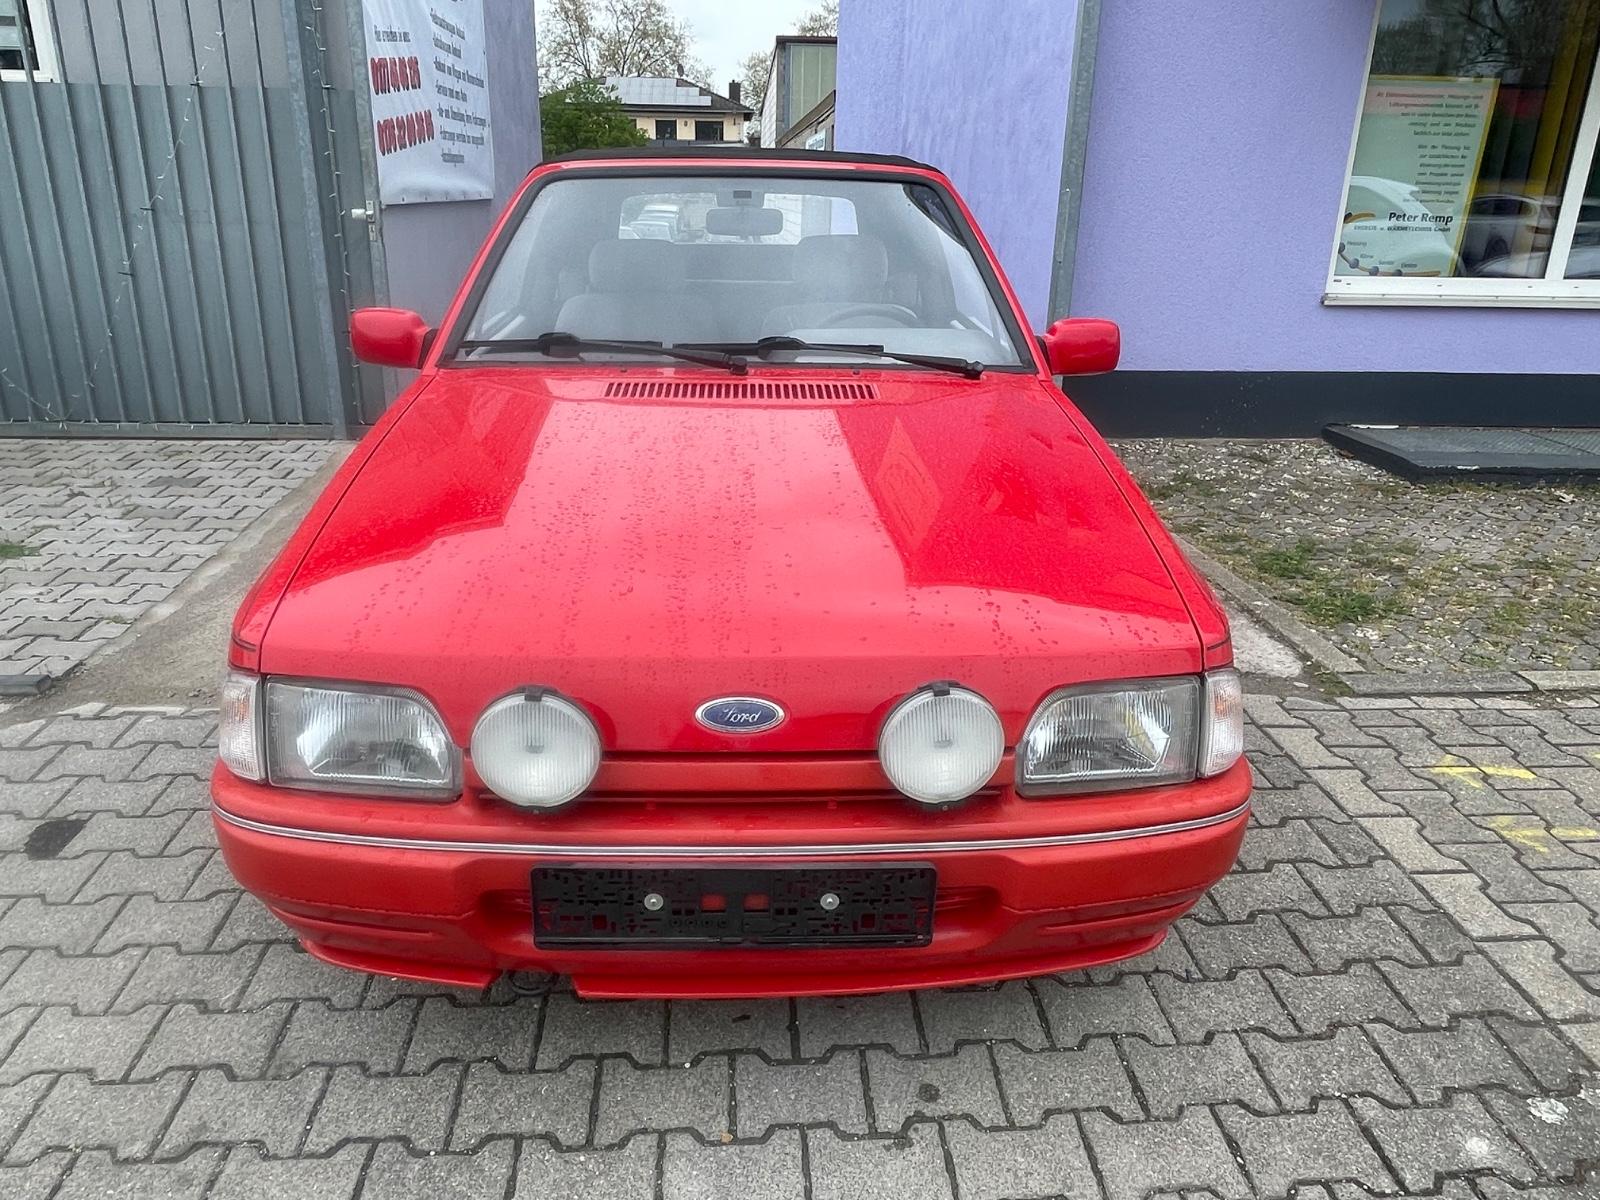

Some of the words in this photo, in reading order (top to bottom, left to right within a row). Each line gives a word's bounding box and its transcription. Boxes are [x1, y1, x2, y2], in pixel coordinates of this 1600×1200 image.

[1388, 212, 1419, 222] Peter
[1420, 212, 1454, 226] Remp
[720, 706, 762, 723] Ford
